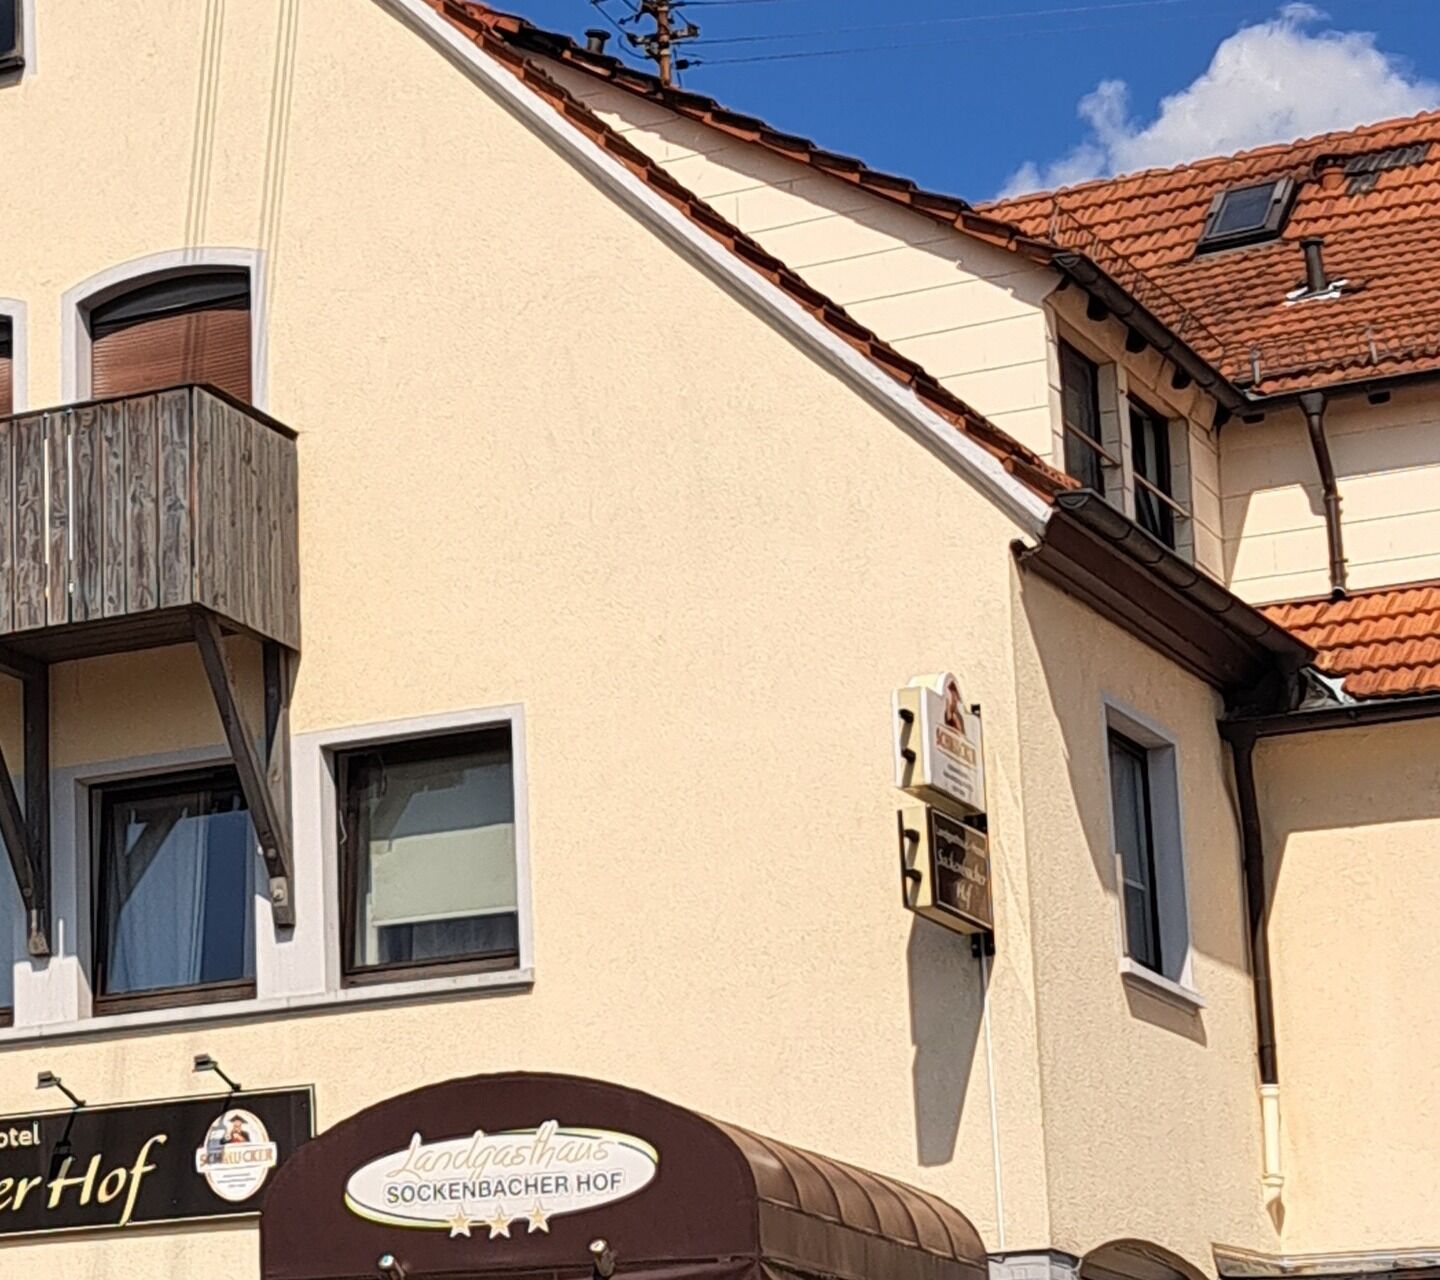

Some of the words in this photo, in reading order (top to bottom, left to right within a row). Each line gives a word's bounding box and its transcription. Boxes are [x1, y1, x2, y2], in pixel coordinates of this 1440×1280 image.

[46, 1134, 167, 1226] Hof
[386, 1122, 614, 1180] Landgasthaus
[386, 1176, 568, 1204] SOCKENBACHER
[576, 1172, 623, 1193] HOF
